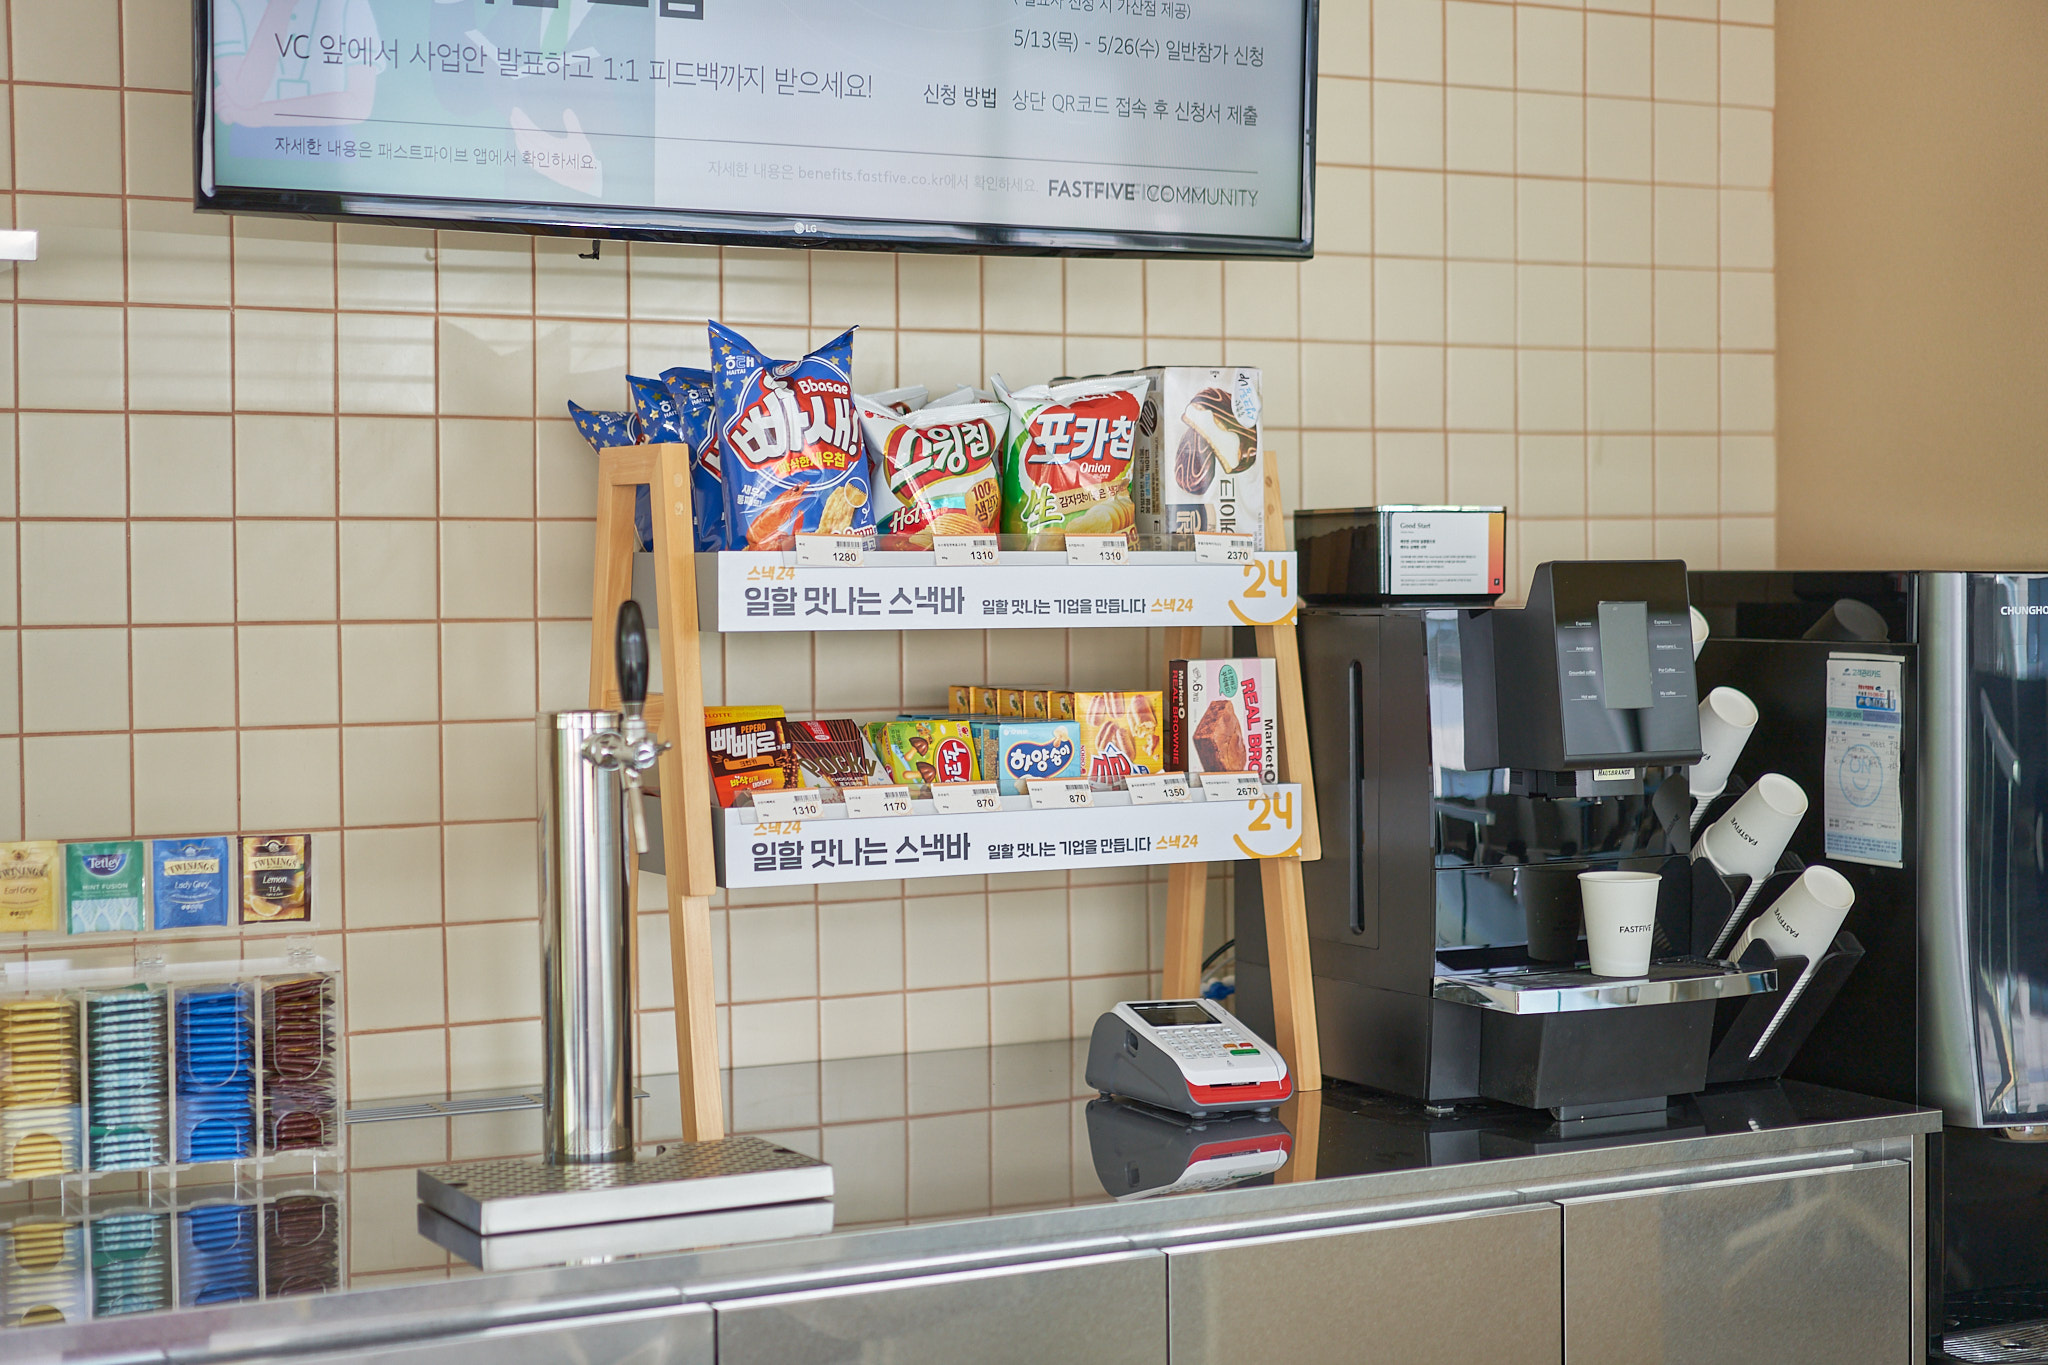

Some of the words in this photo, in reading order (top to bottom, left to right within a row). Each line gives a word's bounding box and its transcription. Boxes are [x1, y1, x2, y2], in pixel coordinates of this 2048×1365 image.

[1117, 0, 1156, 17] 가산점
[1160, 2, 1191, 20] 제공)
[1014, 29, 1079, 53] 5/13(목)
[1098, 36, 1160, 60] 5/26(수)
[1166, 40, 1228, 65] 일반참가
[1234, 46, 1264, 68] 신청
[274, 33, 310, 59] VC
[320, 34, 398, 69] 앞에서
[409, 41, 487, 74] 사업안
[497, 47, 594, 81] 발표하고
[604, 57, 639, 82] 1:1
[649, 58, 765, 94] 피드백까지
[775, 68, 873, 99] 받으세요!
[923, 83, 956, 107] 신청
[963, 86, 997, 109] 방법
[1012, 89, 1046, 112] 상단
[1051, 93, 1110, 115] QR코드
[1115, 96, 1148, 120] 접속
[1153, 99, 1169, 120] 후
[1175, 101, 1221, 124] 신청서
[1226, 104, 1258, 127] 제출
[274, 136, 322, 157] 자세한
[327, 139, 373, 159] 내용은
[378, 143, 468, 164] 패스트파이브
[473, 147, 516, 167] 앱에서
[521, 150, 597, 170] 확인하세요.
[708, 160, 749, 178] 자세한
[753, 162, 794, 180] 내용은
[1048, 179, 1135, 201] FASTFIVE
[1147, 184, 1259, 207] COMMUNITY
[805, 224, 817, 233] LG
[726, 368, 747, 376] HAITAI
[797, 379, 849, 395] Bbasae
[1028, 412, 1136, 466] 포카칩
[890, 421, 990, 493] 스윙칩
[1079, 462, 1111, 474] Onion
[972, 481, 998, 502] 100%
[1021, 483, 1065, 529] 生
[890, 508, 921, 534] Hot
[832, 552, 857, 562] 1280
[970, 551, 994, 561] 1310
[1099, 551, 1122, 561] 1310
[1227, 551, 1248, 560] 2370
[747, 566, 795, 581] 스낵24
[1242, 559, 1288, 598] 24
[745, 586, 798, 617] 일할
[804, 586, 882, 616] 맛나는
[888, 585, 965, 615] 스낵바
[982, 599, 1009, 615] 일할
[1011, 599, 1050, 615] 맛나는
[1054, 599, 1092, 615] 기업을
[1095, 598, 1146, 615] 만듭니다
[1150, 598, 1193, 613] 스낵24
[1241, 677, 1260, 731] REAL
[740, 722, 767, 735] PEPERO
[710, 727, 776, 759] 빼빼로
[1264, 718, 1275, 769] Market
[1010, 744, 1071, 772] 하양송이
[1248, 733, 1263, 772] BRO
[1069, 793, 1087, 803] 870
[1163, 788, 1185, 798] 1350
[1236, 786, 1258, 796] 2670
[792, 805, 817, 816] 1310
[883, 801, 907, 812] 1170
[976, 798, 995, 808] 870
[1247, 791, 1292, 832] 24
[753, 821, 802, 836] 스낵24
[1730, 816, 1759, 846] FASTFIVE
[751, 840, 804, 872] 일할
[810, 837, 888, 869] 맛나는
[894, 832, 971, 864] 스낵바
[987, 843, 1014, 860] 일할
[1017, 842, 1056, 858] 맛나는
[1059, 840, 1098, 856] 기업을
[1100, 837, 1151, 854] 만듭니다
[1155, 834, 1198, 850] 스낵24
[87, 856, 121, 871] Tetley
[168, 862, 215, 875] TWININGS
[252, 858, 299, 870] TWININGS
[0, 866, 45, 879] WININGS
[262, 875, 288, 884] Lemon
[4, 886, 19, 895] Earl
[20, 886, 38, 896] Grey
[101, 882, 129, 890] FUSION
[174, 880, 192, 890] Lady
[192, 880, 209, 890] Grey
[1619, 923, 1652, 933] FASTFIVE
[1774, 906, 1800, 939] FASTFIVE
